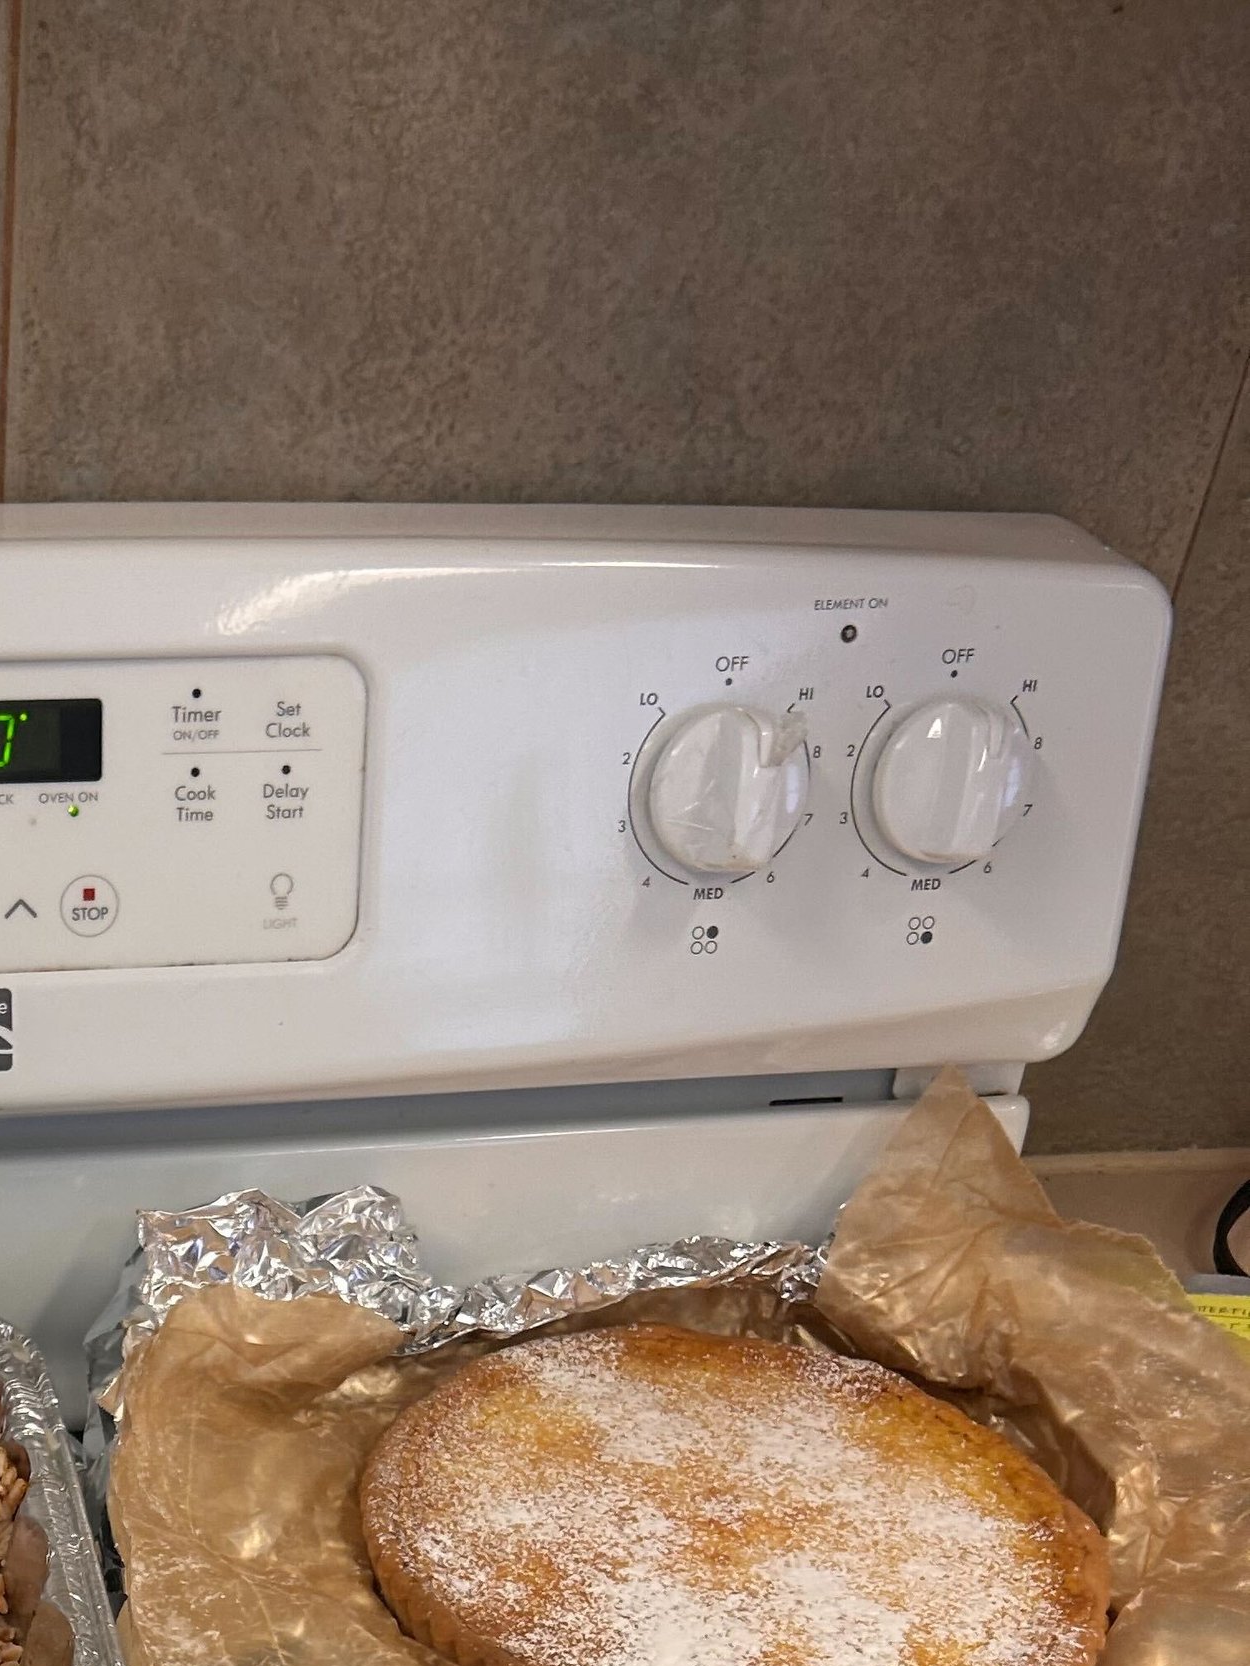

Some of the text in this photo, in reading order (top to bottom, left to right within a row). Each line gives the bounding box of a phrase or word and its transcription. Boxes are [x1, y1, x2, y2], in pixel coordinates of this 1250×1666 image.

[814, 597, 889, 610] ELEMENT ON
[941, 649, 975, 664] OFF
[716, 656, 749, 672] OFF
[865, 685, 884, 699] LO
[1022, 680, 1039, 694] HI
[640, 693, 658, 707] LO
[798, 687, 814, 702] HI
[172, 705, 222, 724] Timer
[276, 701, 302, 717] Set
[172, 729, 220, 742] ON/OFF
[265, 722, 311, 738] Clock
[1033, 737, 1043, 750] 8
[812, 745, 821, 759] 8
[846, 745, 856, 758] 2
[622, 752, 632, 766] 2
[38, 791, 98, 804] OVEN ON
[174, 785, 217, 802] Cook
[262, 783, 309, 800] Delay
[176, 806, 214, 822] Time
[266, 804, 304, 820] Start
[1023, 804, 1032, 817] 7
[804, 813, 813, 827] 7
[839, 812, 848, 825] 3
[617, 820, 626, 833] 3
[861, 867, 870, 881] 4
[983, 861, 993, 875] 6
[641, 876, 651, 890] 4
[766, 870, 775, 884] 6
[910, 877, 941, 892] MED
[693, 887, 724, 901] MED
[71, 906, 109, 921] STOP
[262, 918, 298, 930] LIGHT
